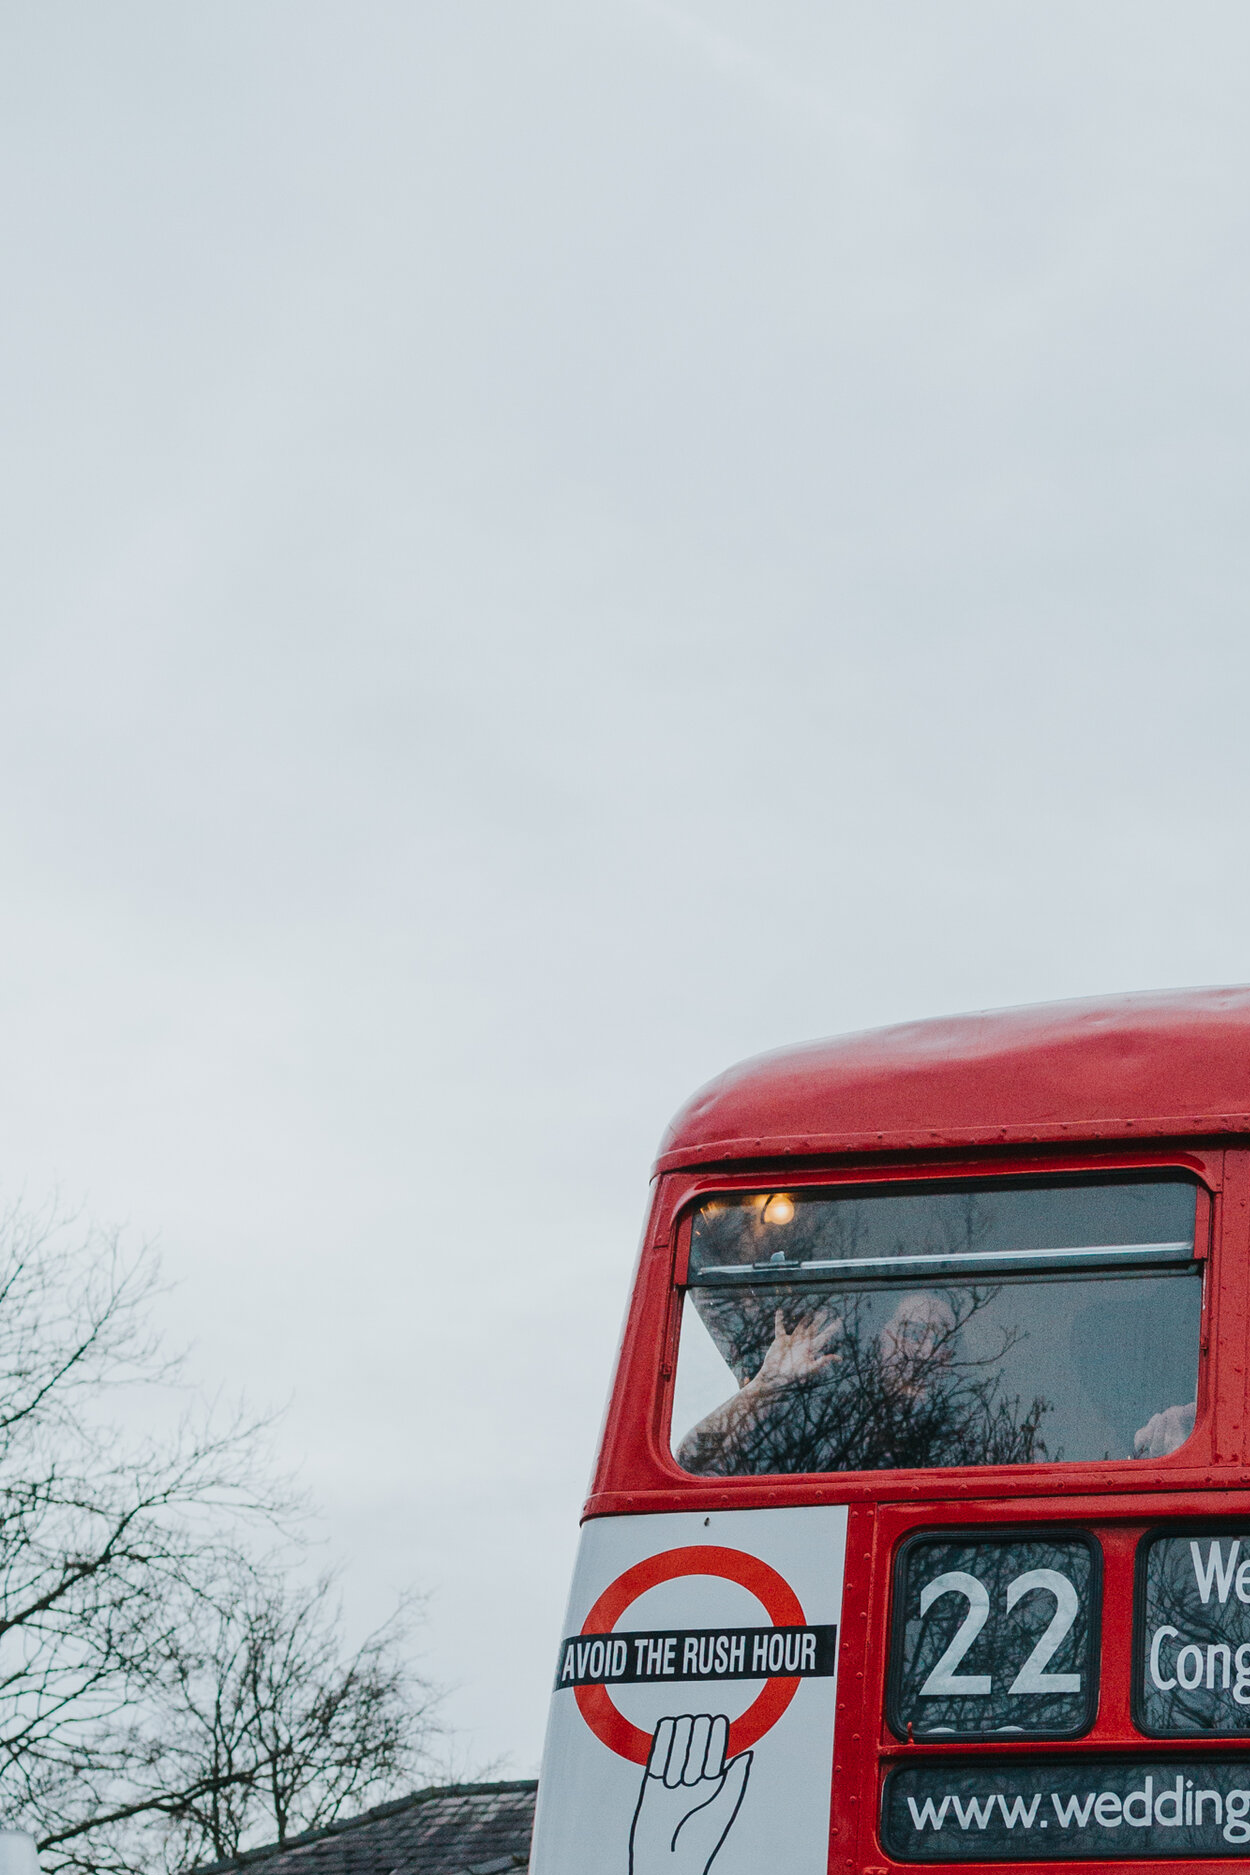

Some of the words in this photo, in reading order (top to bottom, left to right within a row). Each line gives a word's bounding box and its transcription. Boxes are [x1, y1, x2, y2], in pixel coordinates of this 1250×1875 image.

[562, 1640, 628, 1682] AVOID
[635, 1638, 678, 1676] THE
[683, 1636, 746, 1674] RUSH
[752, 1633, 817, 1672] HOUR
[919, 1568, 1081, 1696] 22
